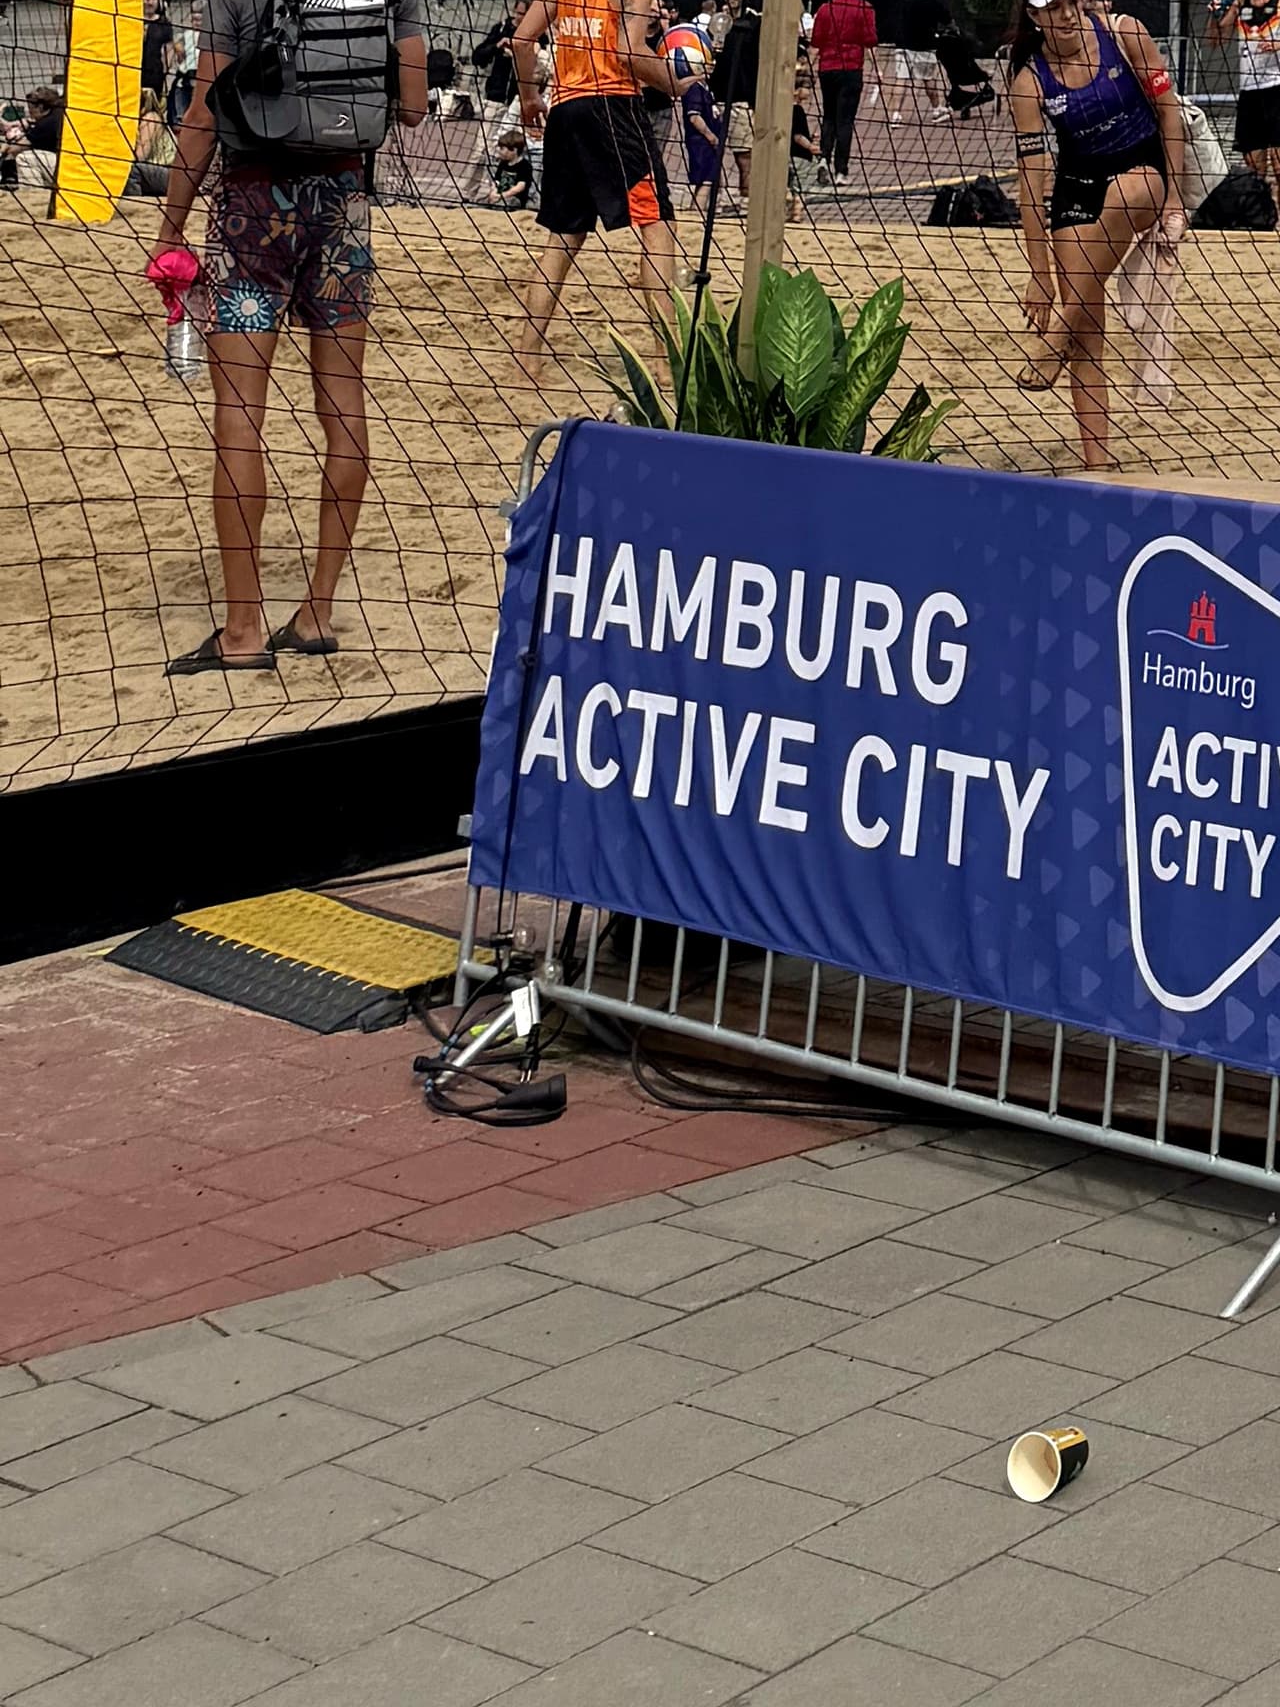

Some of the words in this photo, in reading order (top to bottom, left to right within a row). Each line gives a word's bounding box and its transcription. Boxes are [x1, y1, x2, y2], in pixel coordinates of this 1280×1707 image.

[542, 533, 968, 705] HAMBURG
[1142, 650, 1256, 710] Hamburg
[520, 675, 816, 832] ACTIVE
[841, 735, 1050, 879] CITY
[1150, 814, 1276, 898] CITY
